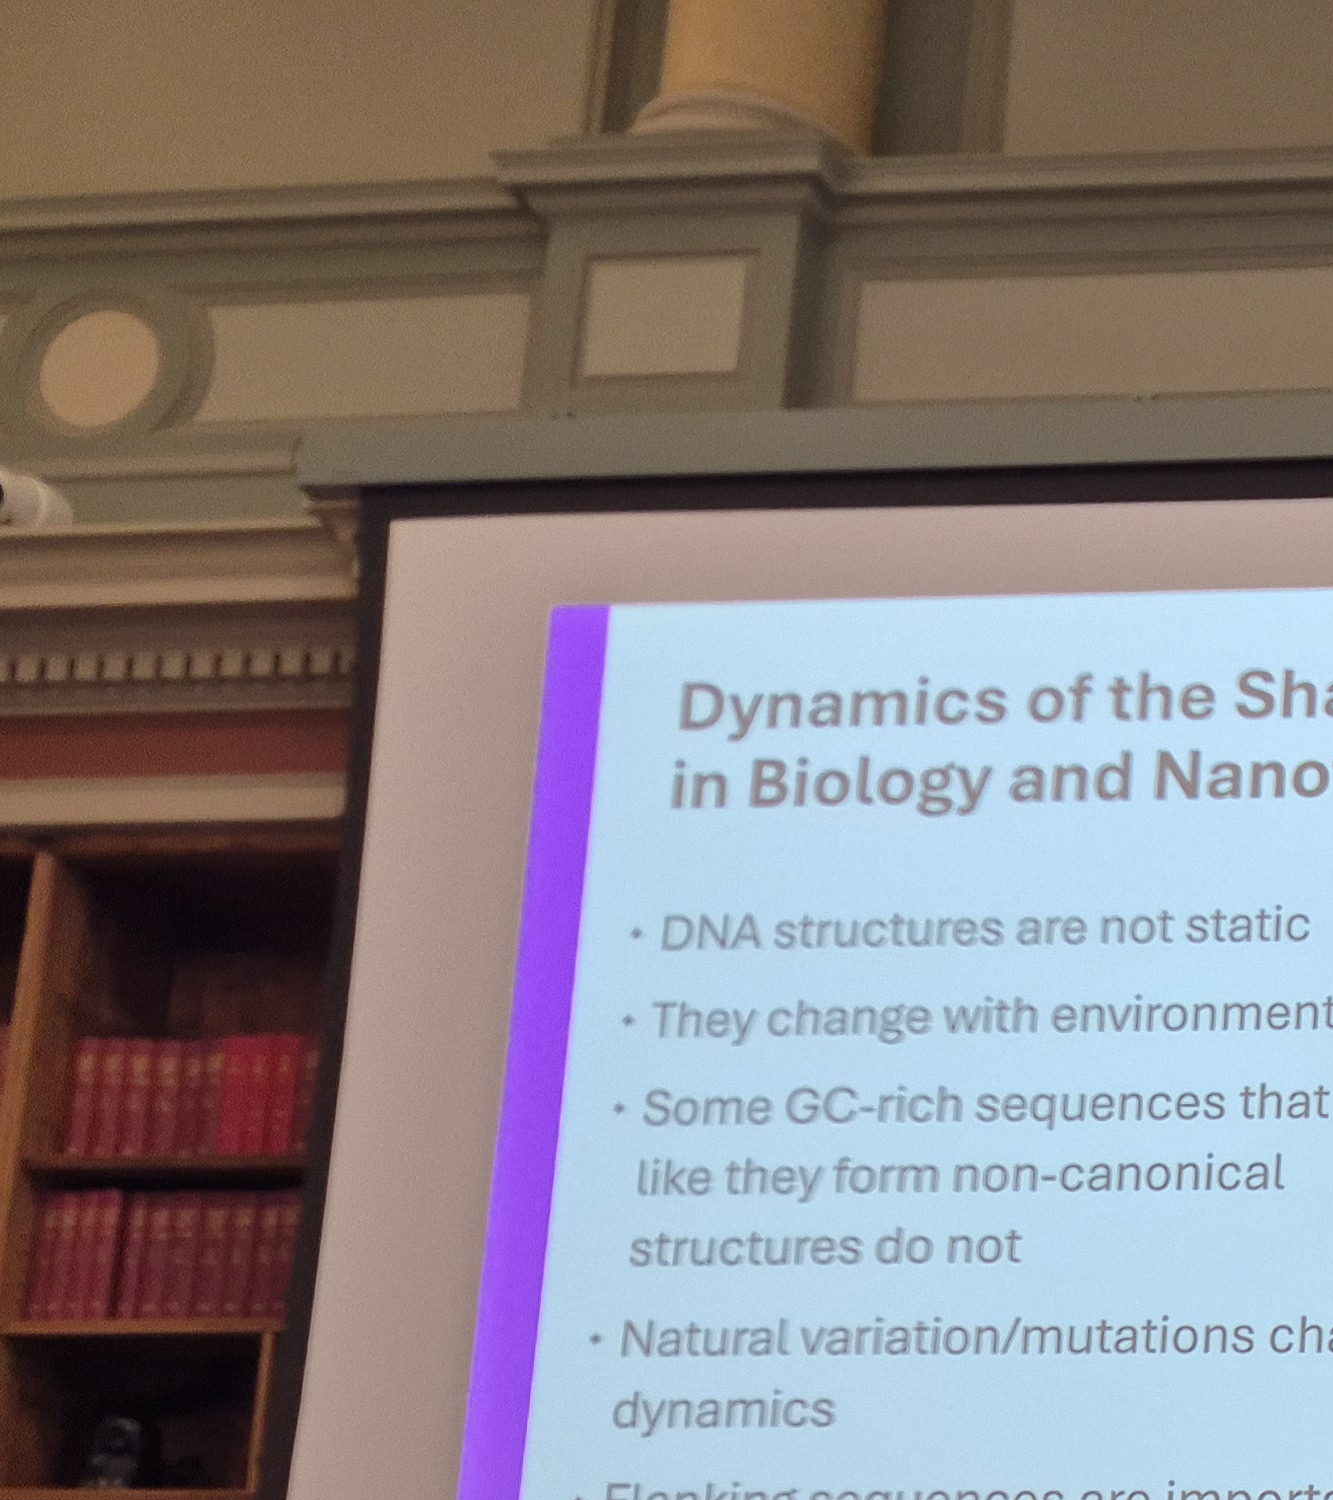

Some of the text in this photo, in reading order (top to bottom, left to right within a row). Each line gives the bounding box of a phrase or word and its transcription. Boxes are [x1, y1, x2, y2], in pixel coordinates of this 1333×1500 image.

[679, 675, 1008, 743] Dynamics
[1026, 672, 1094, 723] of
[1107, 669, 1216, 722] the
[670, 759, 729, 810] in
[749, 754, 995, 818] Biology
[1009, 750, 1134, 803] and
[661, 904, 1310, 952] DNA structures are not static
[652, 1001, 758, 1047] They
[767, 999, 933, 1045] change
[943, 996, 1038, 1034] with
[643, 1088, 773, 1127] Some
[785, 1085, 963, 1124] GC-rich
[975, 1091, 1225, 1131] sequences
[1239, 1082, 1330, 1120] that
[637, 1153, 1285, 1203] like they form non-canonical
[629, 1227, 1023, 1267] structures do not
[621, 1318, 791, 1357] Natural
[800, 1315, 1254, 1356] variation/mutations
[613, 1391, 836, 1438] dynamics
